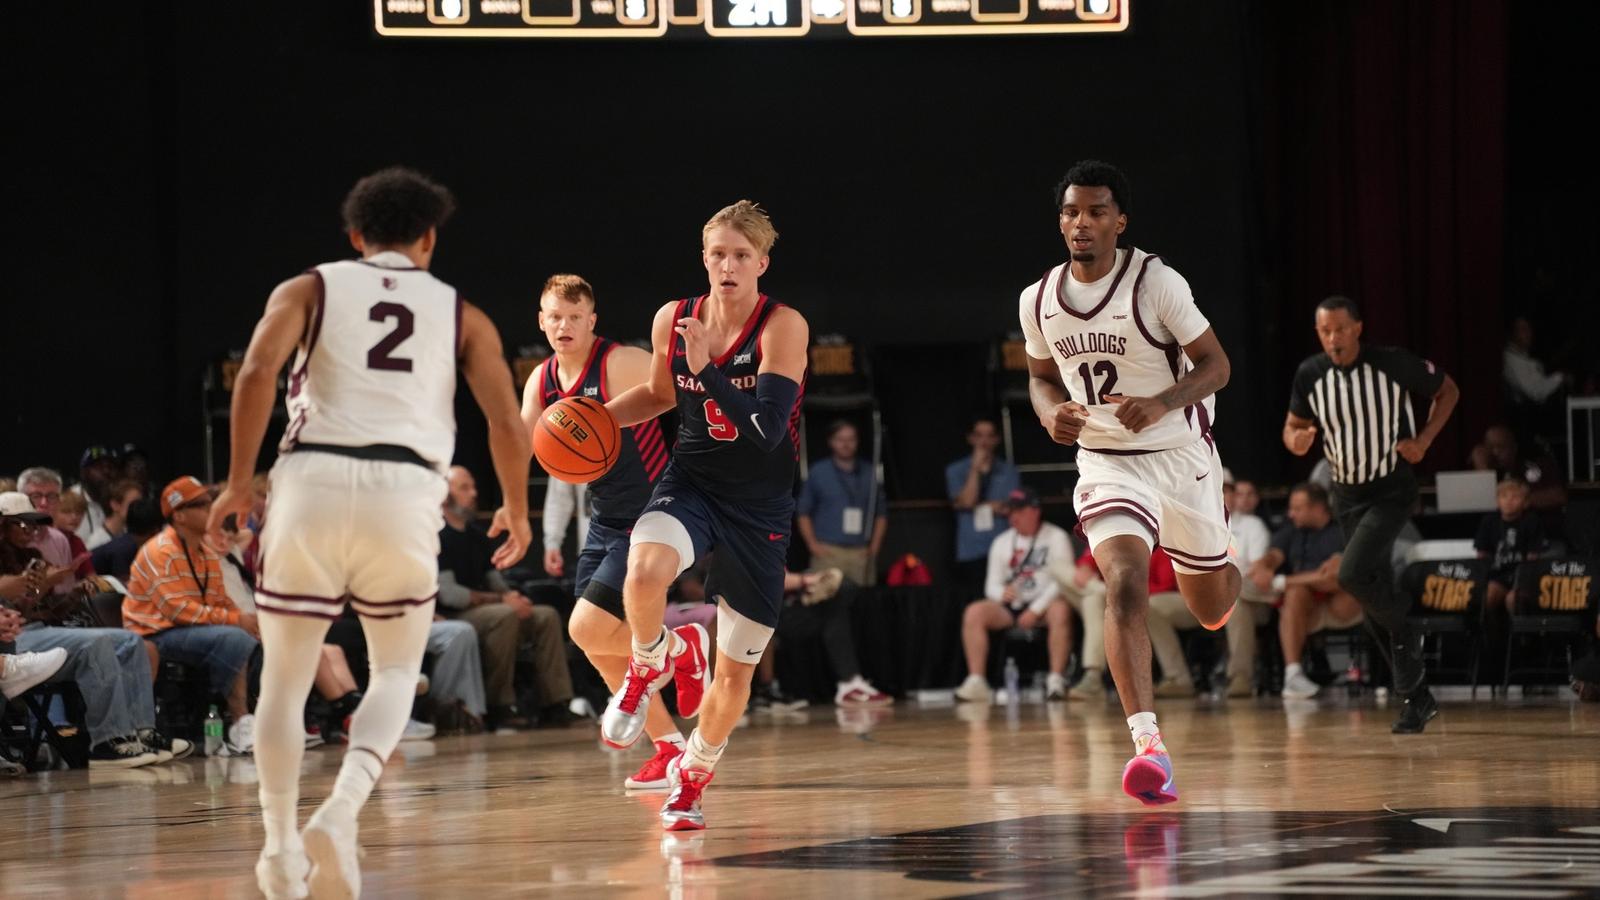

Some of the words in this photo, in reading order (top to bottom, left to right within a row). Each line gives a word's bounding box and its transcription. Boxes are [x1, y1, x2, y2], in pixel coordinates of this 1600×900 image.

[367, 301, 414, 373] 2
[1054, 332, 1127, 360] BULLDOGS
[1078, 360, 1123, 406] 12
[547, 408, 590, 444] ELITE
[703, 399, 739, 442] 9
[1422, 573, 1476, 612] STAGE
[1538, 575, 1592, 611] STAGE
